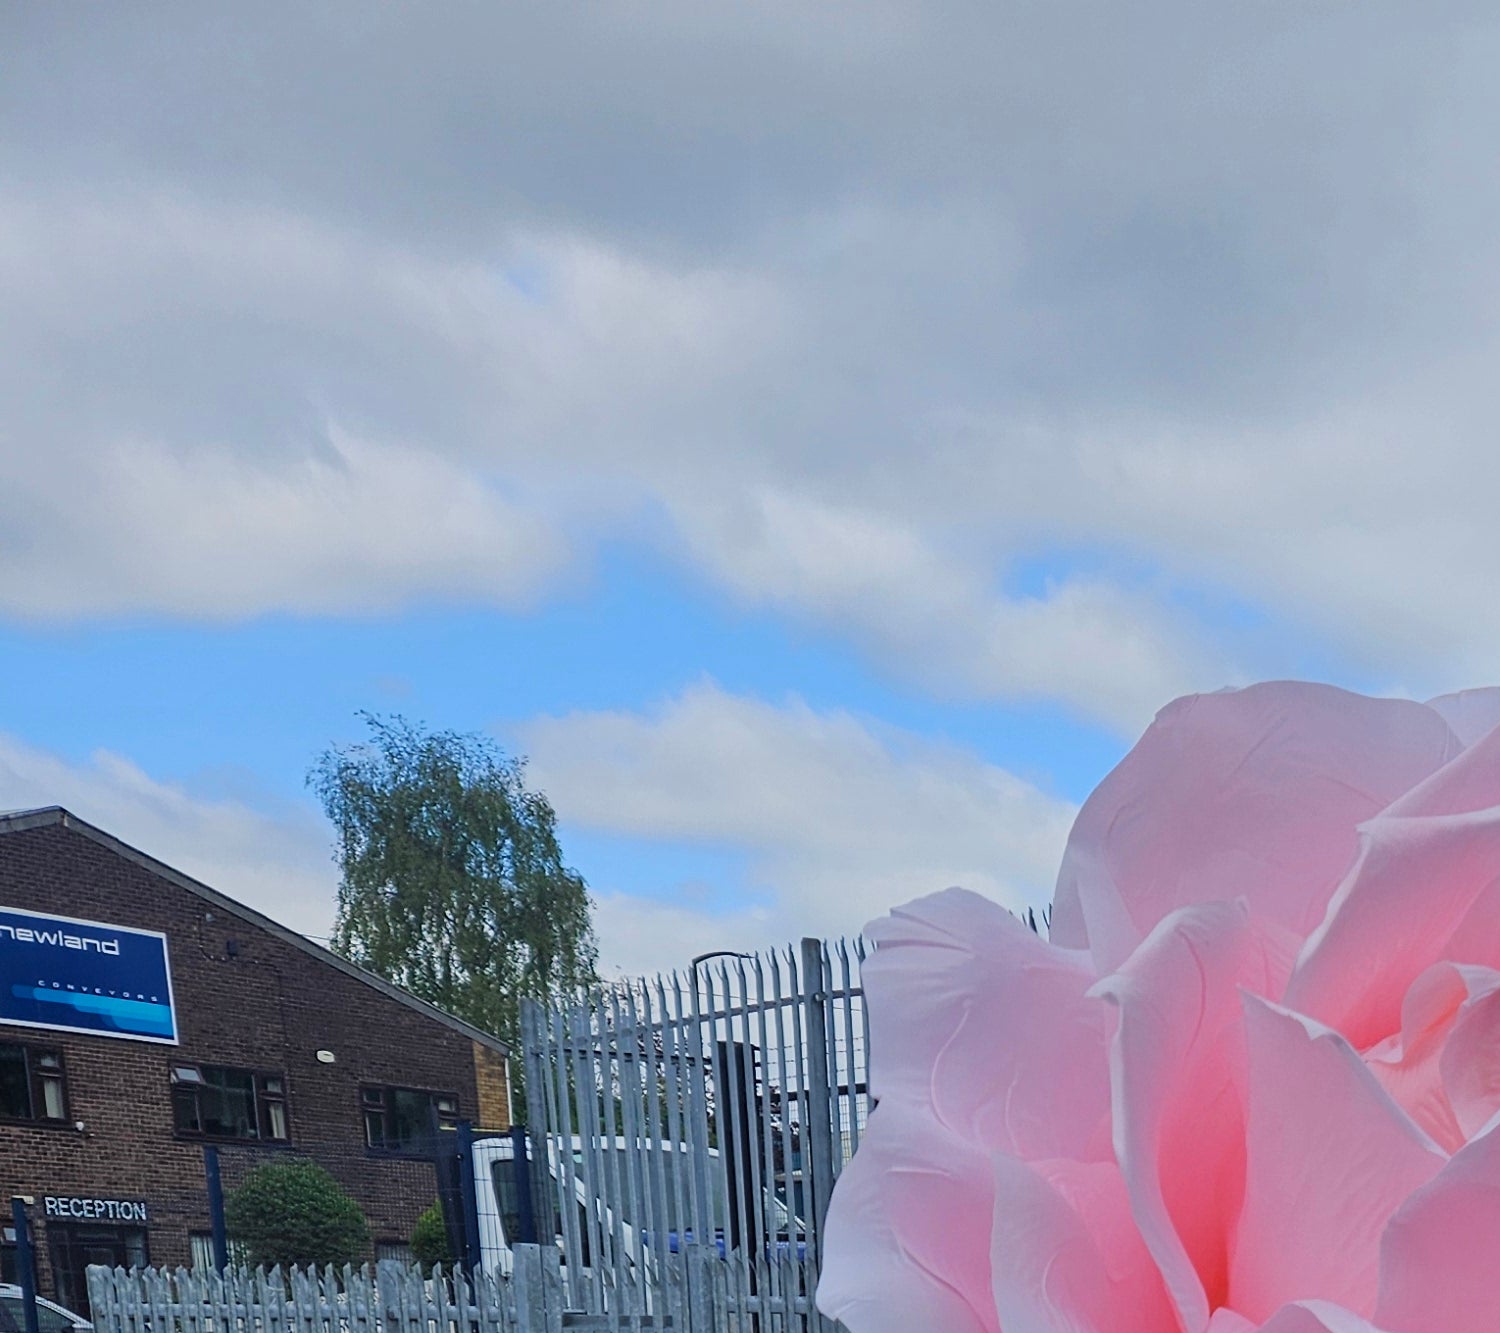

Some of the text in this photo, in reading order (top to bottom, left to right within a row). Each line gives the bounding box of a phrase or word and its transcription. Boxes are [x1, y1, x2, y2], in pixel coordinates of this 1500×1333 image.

[0, 925, 120, 955] newland
[38, 980, 157, 1002] CONVEYORS
[44, 1197, 146, 1221] RECEPTION
